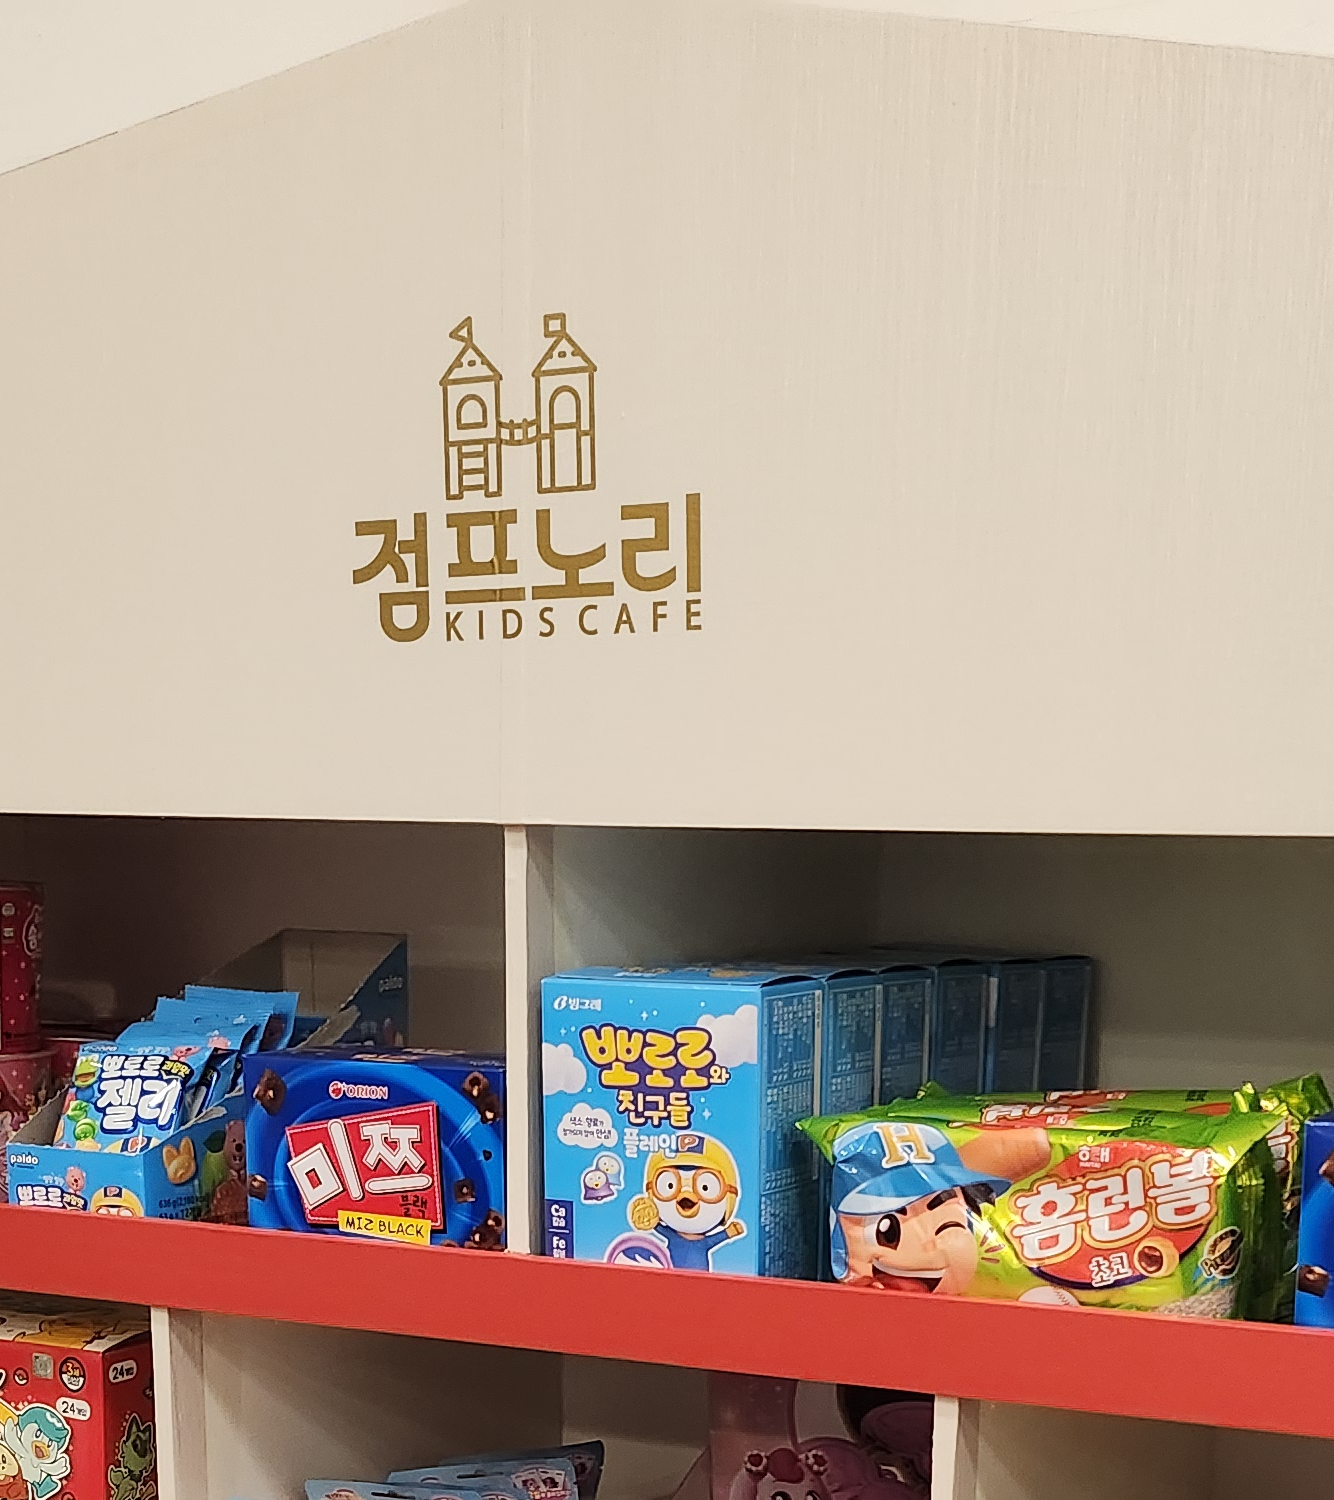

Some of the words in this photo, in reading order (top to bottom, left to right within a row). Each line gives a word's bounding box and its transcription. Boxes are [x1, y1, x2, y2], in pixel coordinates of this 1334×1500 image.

[353, 492, 702, 643] 점프노리
[445, 605, 556, 643] KIDS
[577, 598, 703, 637] CAFE
[101, 1055, 163, 1078] 뽀로로
[97, 1078, 182, 1130] 젤리
[344, 1082, 389, 1100] ORION
[616, 1090, 696, 1128] 친구들
[622, 1126, 678, 1158] 플레인
[877, 1121, 936, 1168] H
[10, 1153, 39, 1166] paldo
[286, 1118, 433, 1211] 미쯔
[17, 1185, 64, 1207] 뽀로로
[550, 1204, 567, 1218] Ca
[1011, 1148, 1221, 1263] 홈런볼
[377, 1218, 425, 1240] BLACK
[552, 1236, 567, 1249] Fe
[1088, 1251, 1133, 1287] 초코
